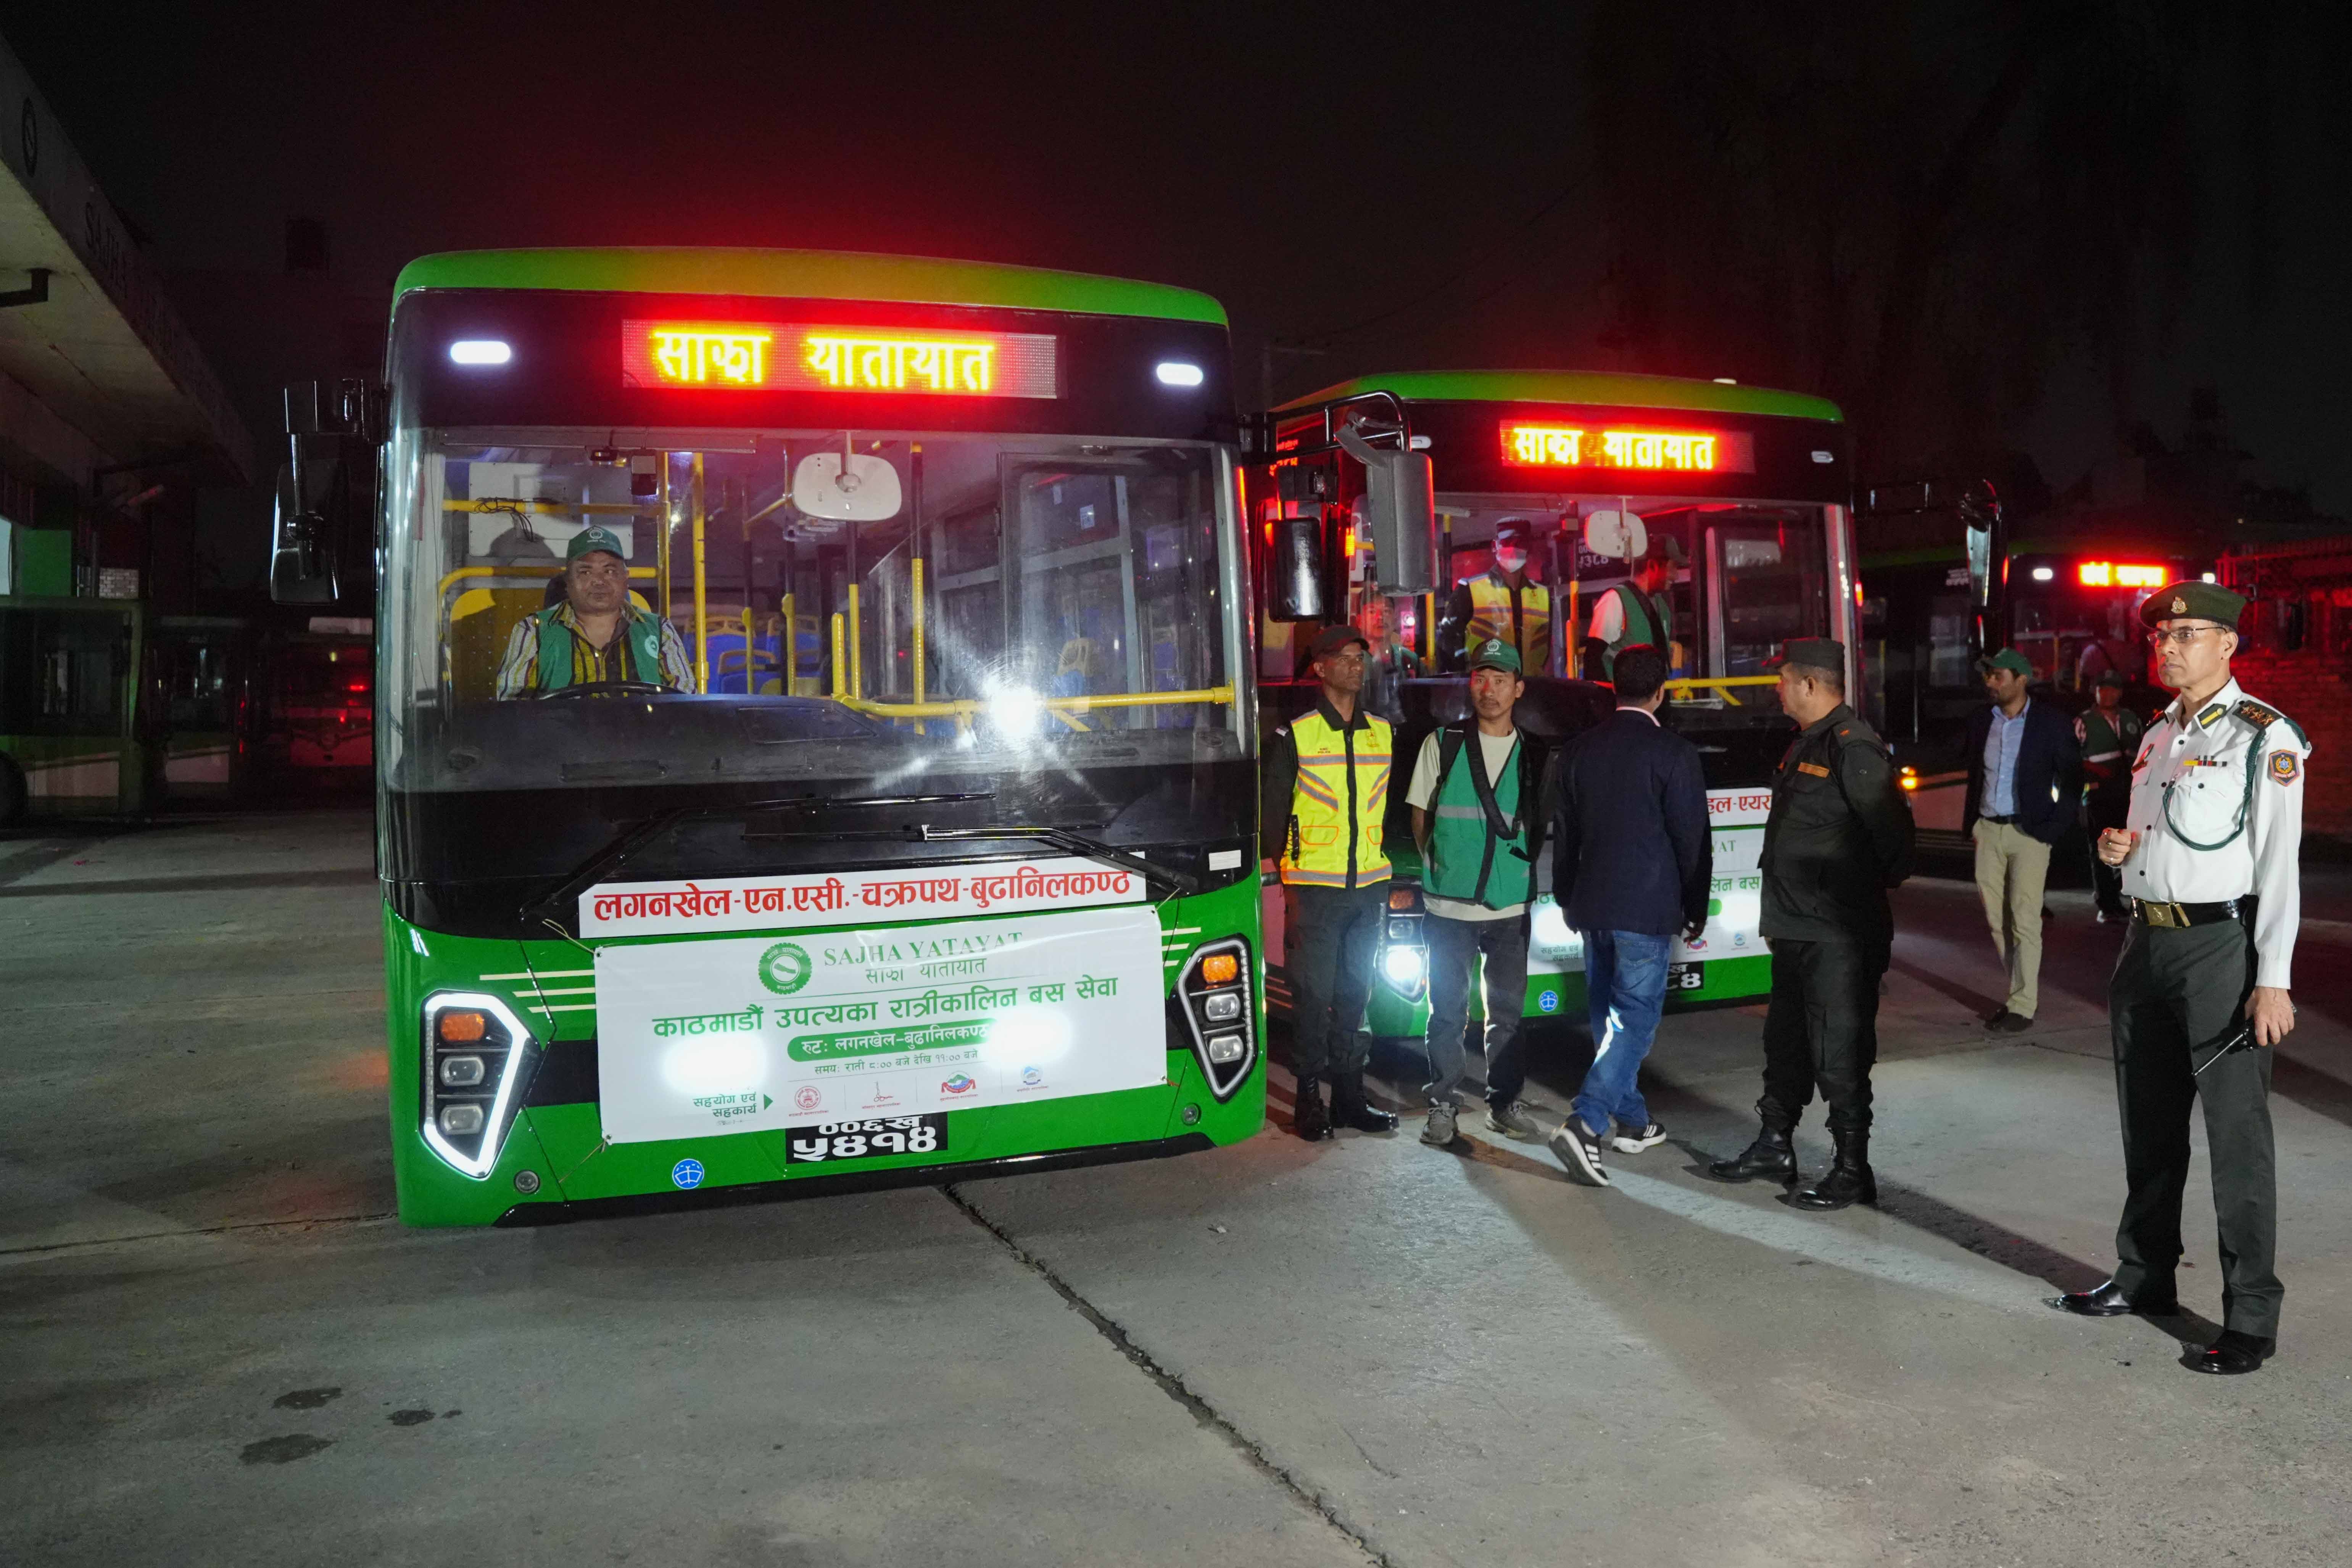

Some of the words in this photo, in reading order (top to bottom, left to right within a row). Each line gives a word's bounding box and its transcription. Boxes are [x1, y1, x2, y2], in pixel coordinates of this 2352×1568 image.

[806, 337, 995, 391] यातायात
[824, 944, 903, 966] SAJHA
[909, 931, 1023, 959] YATAYAT
[920, 958, 988, 979] यातायात
[652, 1004, 764, 1037] काठमाडौं
[775, 1001, 878, 1029] उपत्यका
[888, 984, 1018, 1019] रात्रीकालिन
[1028, 983, 1066, 1004] बस
[1075, 974, 1119, 1000] सेवा
[844, 1059, 865, 1072] राती
[895, 1056, 910, 1066] बजे
[914, 1053, 932, 1065] देखि
[693, 1093, 736, 1108] सहयोग
[741, 1091, 757, 1103] एवं
[712, 1103, 757, 1118] सहकार्य
[793, 1127, 937, 1162] ५४१४
